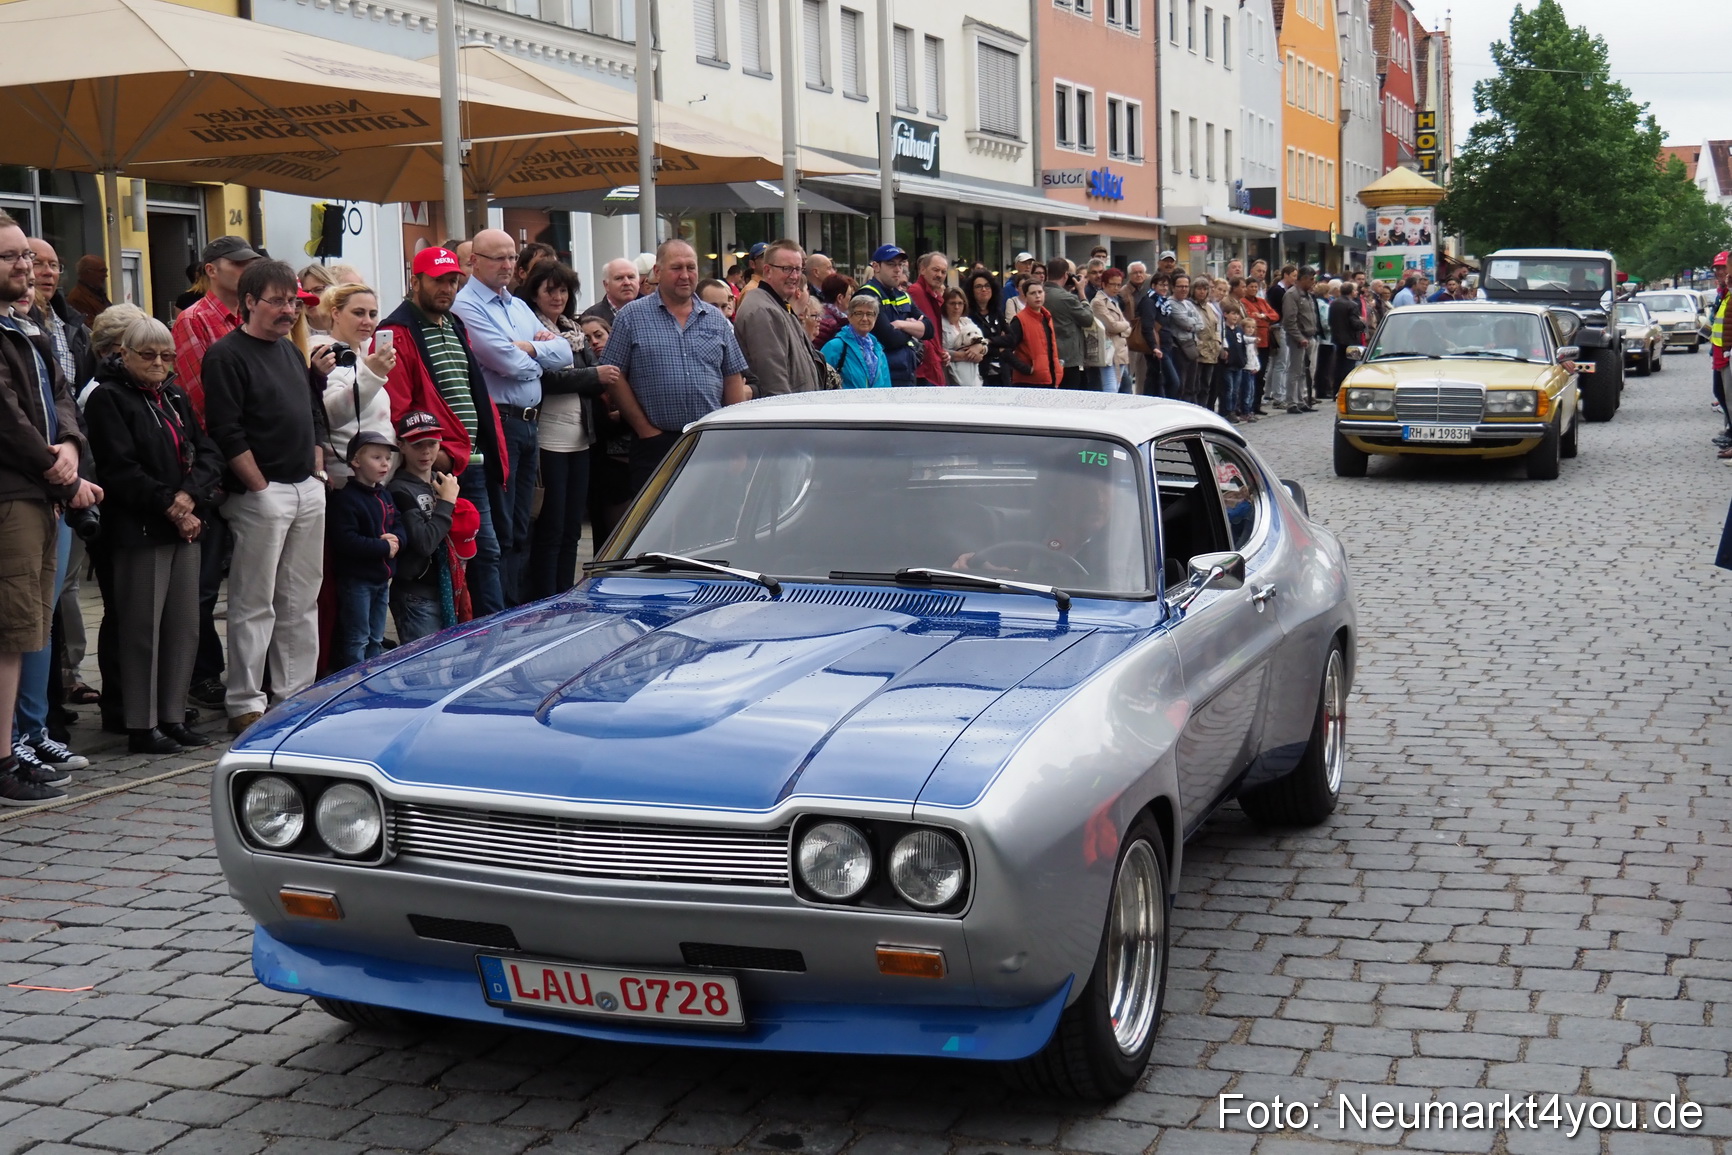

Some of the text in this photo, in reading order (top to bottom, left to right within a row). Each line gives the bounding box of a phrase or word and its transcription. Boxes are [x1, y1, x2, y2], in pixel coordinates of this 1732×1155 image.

[891, 122, 938, 170] frühauf
[1417, 113, 1435, 182] HOT
[229, 209, 243, 226] 24
[435, 257, 456, 265] DEKRA
[406, 412, 420, 427] NEW
[1409, 427, 1470, 440] RH W 1983H
[1079, 451, 1108, 466] 175
[510, 964, 594, 1006] LAU
